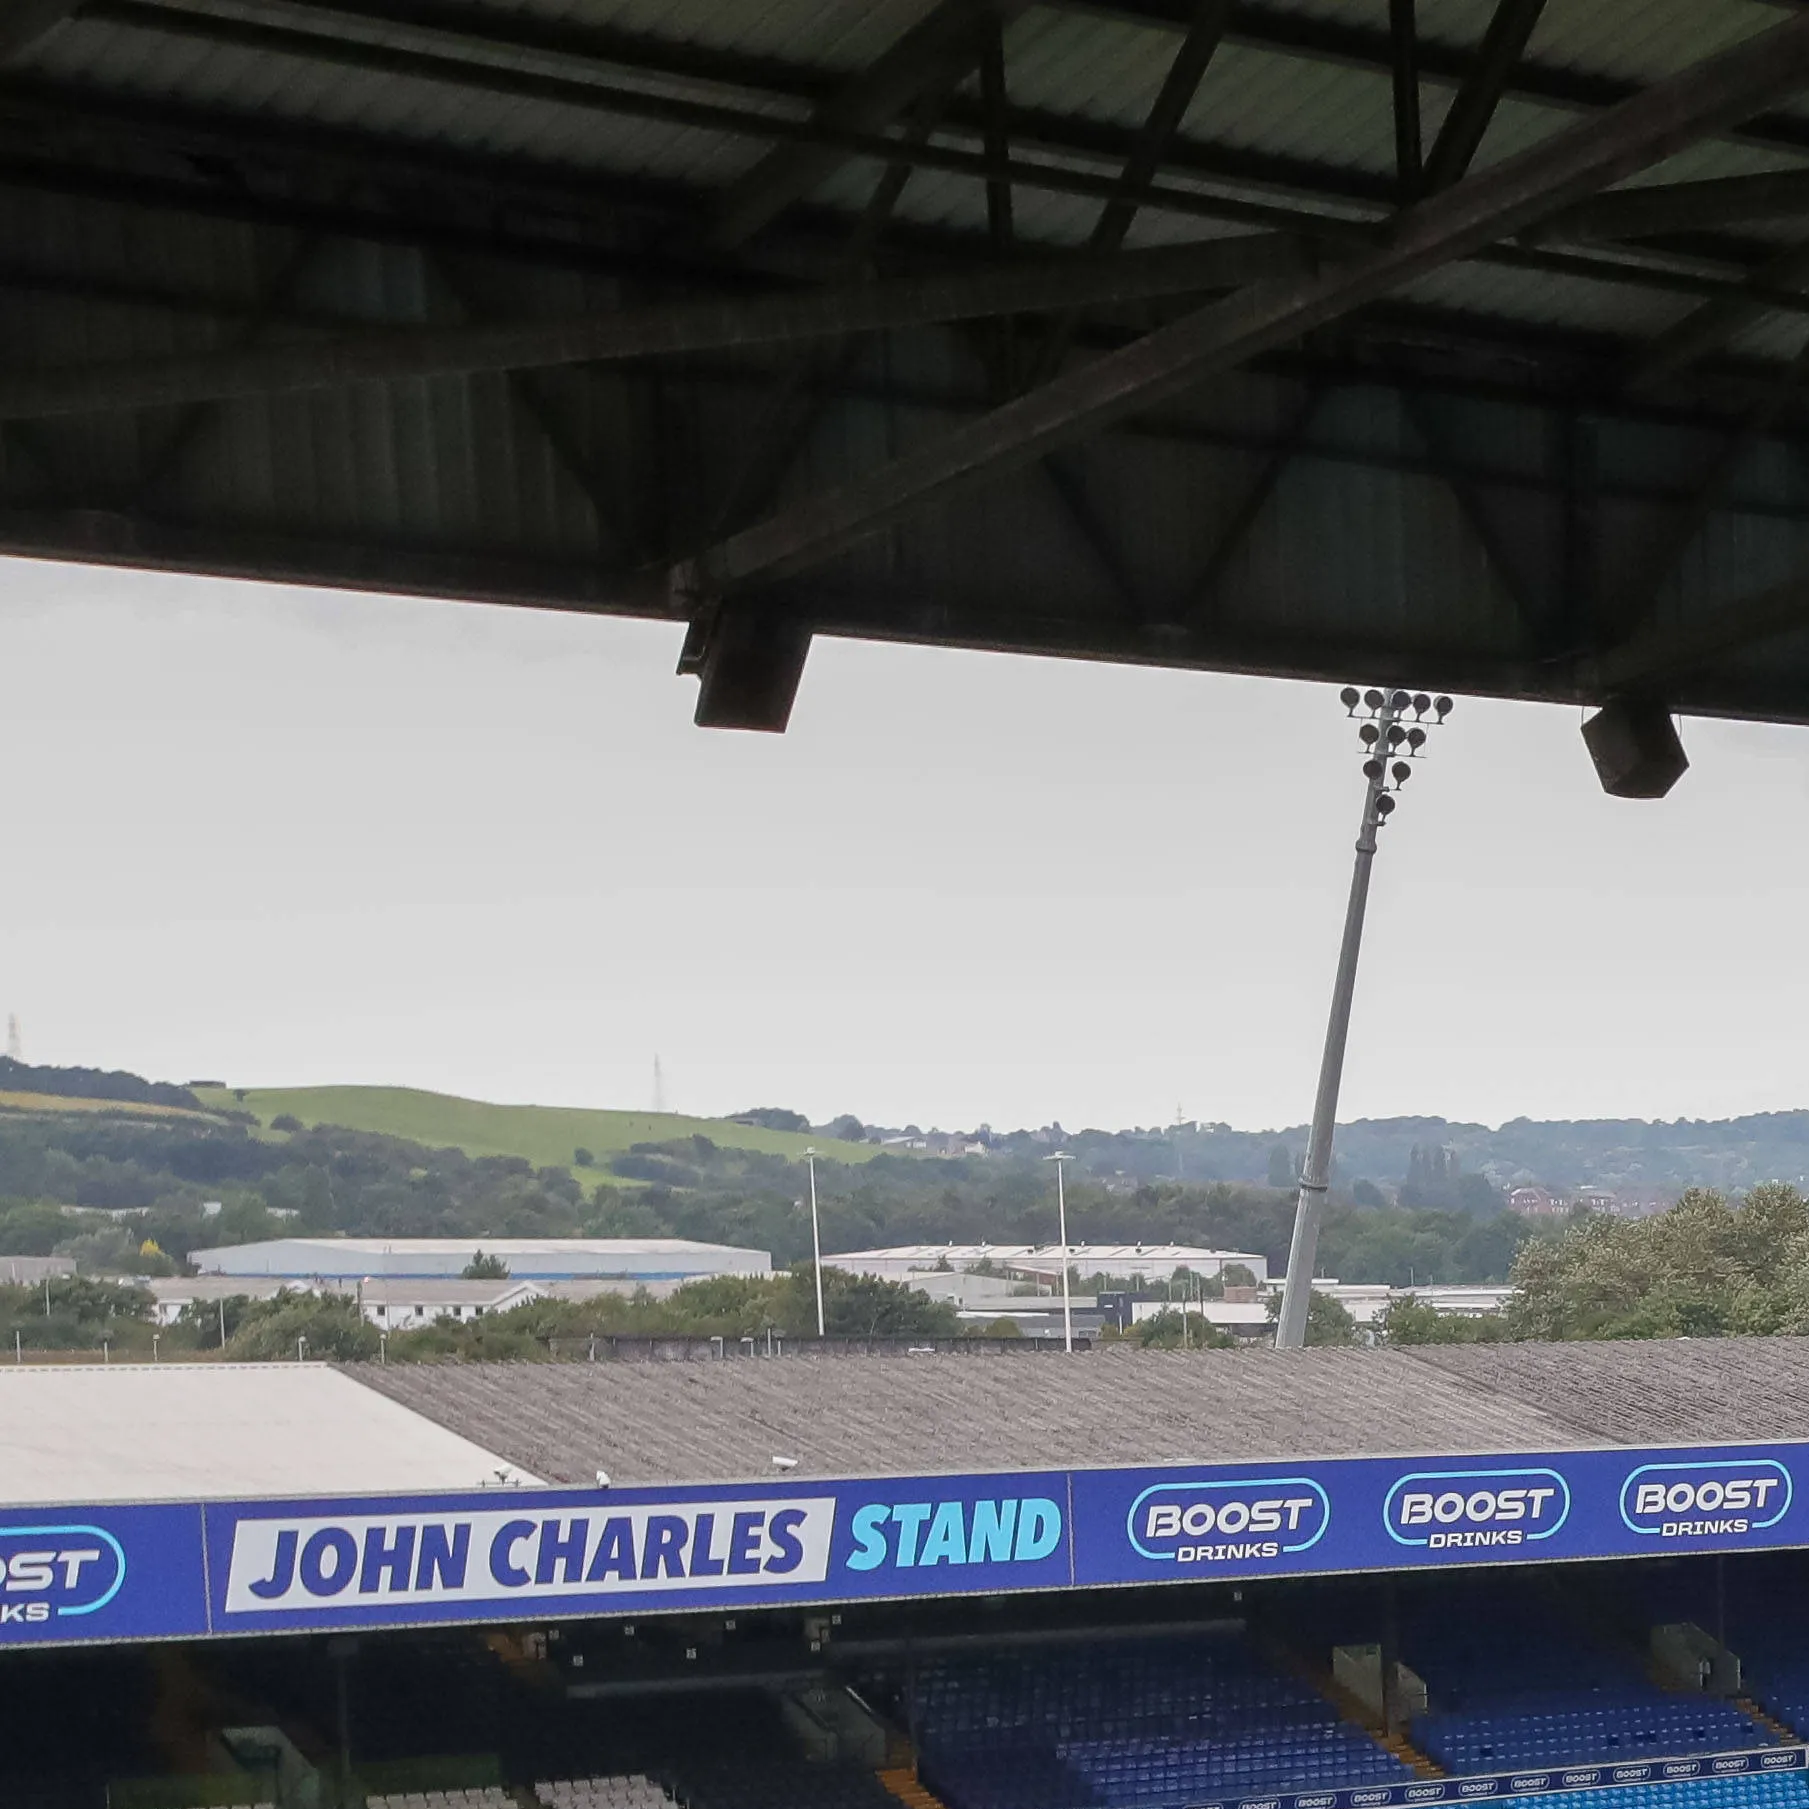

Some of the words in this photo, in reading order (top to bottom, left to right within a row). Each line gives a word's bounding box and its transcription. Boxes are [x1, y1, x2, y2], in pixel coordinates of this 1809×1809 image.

[1636, 1479, 1777, 1513] BOOST
[1401, 1489, 1554, 1524] BOOST
[1146, 1499, 1312, 1537] BOOST
[1658, 1519, 1748, 1536] DRINKS
[1430, 1531, 1522, 1547] DRINKS
[249, 1524, 471, 1598] JOHN
[488, 1509, 807, 1587] CHARLES
[846, 1498, 1061, 1570] STAND
[1178, 1543, 1278, 1561] DRINKS
[1717, 1758, 1744, 1769] BOOST
[1765, 1754, 1792, 1764] BOOST
[1618, 1767, 1648, 1778] BOOST
[1667, 1763, 1697, 1774] BOOST
[1515, 1777, 1546, 1788] BOOST
[1566, 1771, 1597, 1782] BOOST
[1409, 1786, 1440, 1797] BOOST
[1463, 1781, 1495, 1793] BOOST
[1299, 1797, 1331, 1809] BOOST
[1355, 1793, 1386, 1804] BOOST
